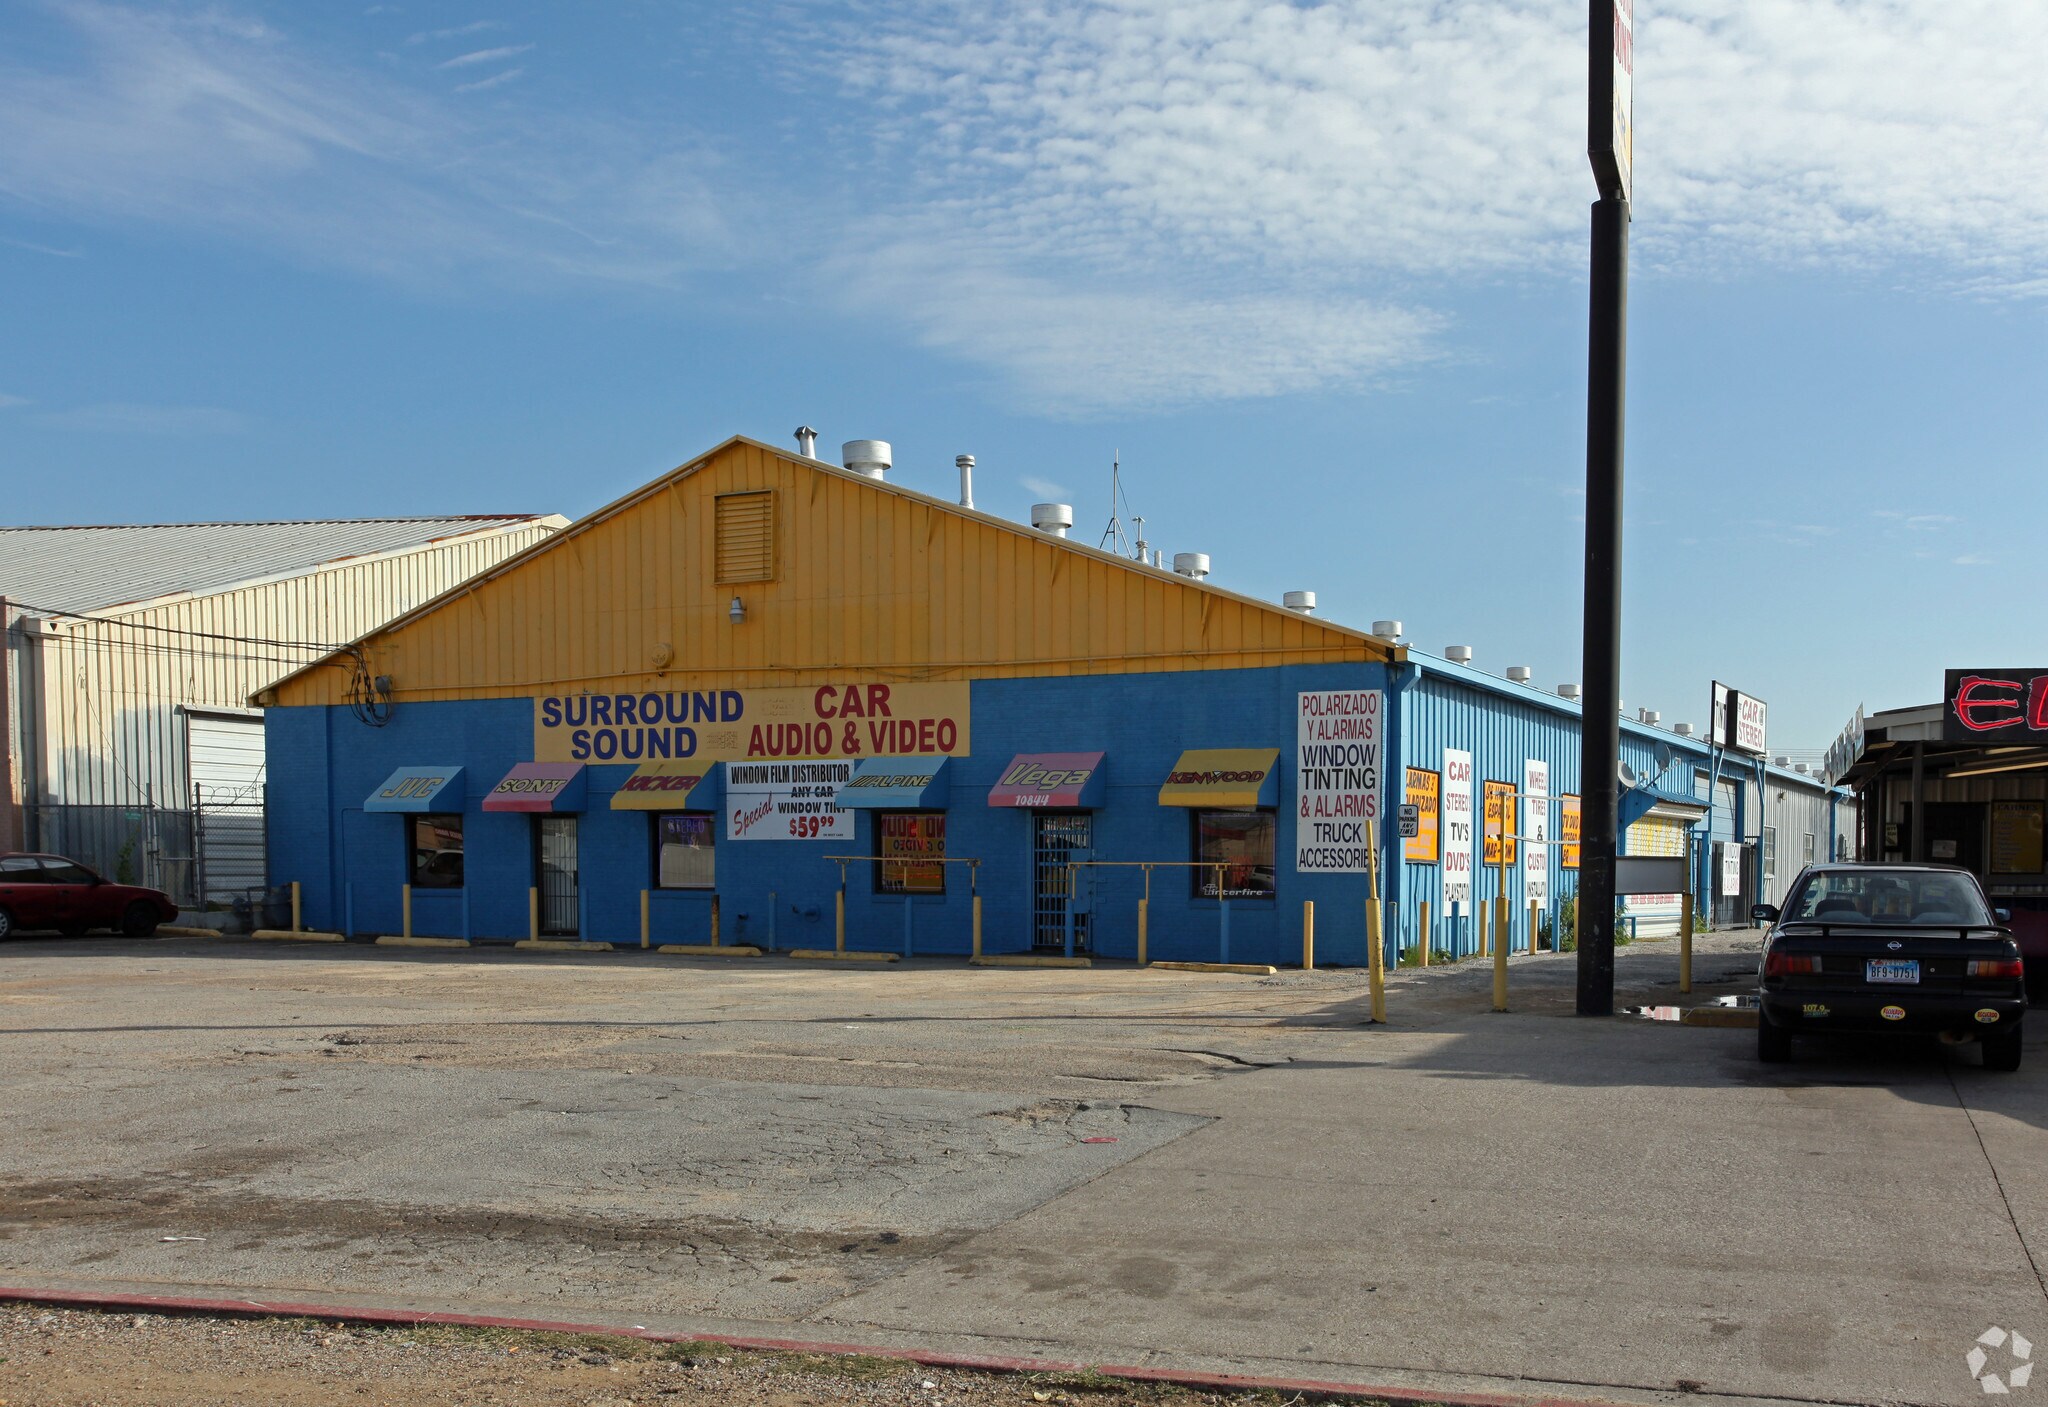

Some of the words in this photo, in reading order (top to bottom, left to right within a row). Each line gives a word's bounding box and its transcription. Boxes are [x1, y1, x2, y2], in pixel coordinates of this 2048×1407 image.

[542, 690, 744, 728] SURROUND
[814, 684, 892, 720] CAR
[1303, 693, 1377, 717] POLARIZADO
[1742, 700, 1758, 723] CAR
[747, 723, 834, 757] AUDIO
[841, 720, 861, 754] &
[869, 718, 957, 753] VIDEO
[1307, 719, 1315, 740] Y
[1317, 718, 1373, 740] ALARMAS
[1738, 721, 1763, 748] STEREO
[571, 726, 698, 760] SOUND
[1302, 744, 1376, 767] WINDOW
[731, 765, 769, 784] WINDOW
[770, 765, 790, 783] FILM
[792, 763, 849, 783] DISTRIBUTOR
[1002, 762, 1092, 790] Vega
[1166, 770, 1265, 785] KENWOOD
[1302, 768, 1376, 790] TINTING
[1448, 761, 1470, 782] CAR
[381, 777, 444, 798] JVC
[495, 778, 567, 794] SONY
[791, 786, 812, 798] ANY
[814, 786, 833, 798] CAR
[777, 802, 822, 814] WINDOW
[1015, 794, 1049, 806] 10844
[1301, 794, 1310, 817] &
[1315, 794, 1376, 818] ALARMS
[733, 790, 773, 836] Special
[1403, 808, 1413, 816] NO
[1314, 822, 1362, 843] TRUCK
[1451, 821, 1469, 842] TV'S
[1299, 848, 1378, 868] ACCESSORIES
